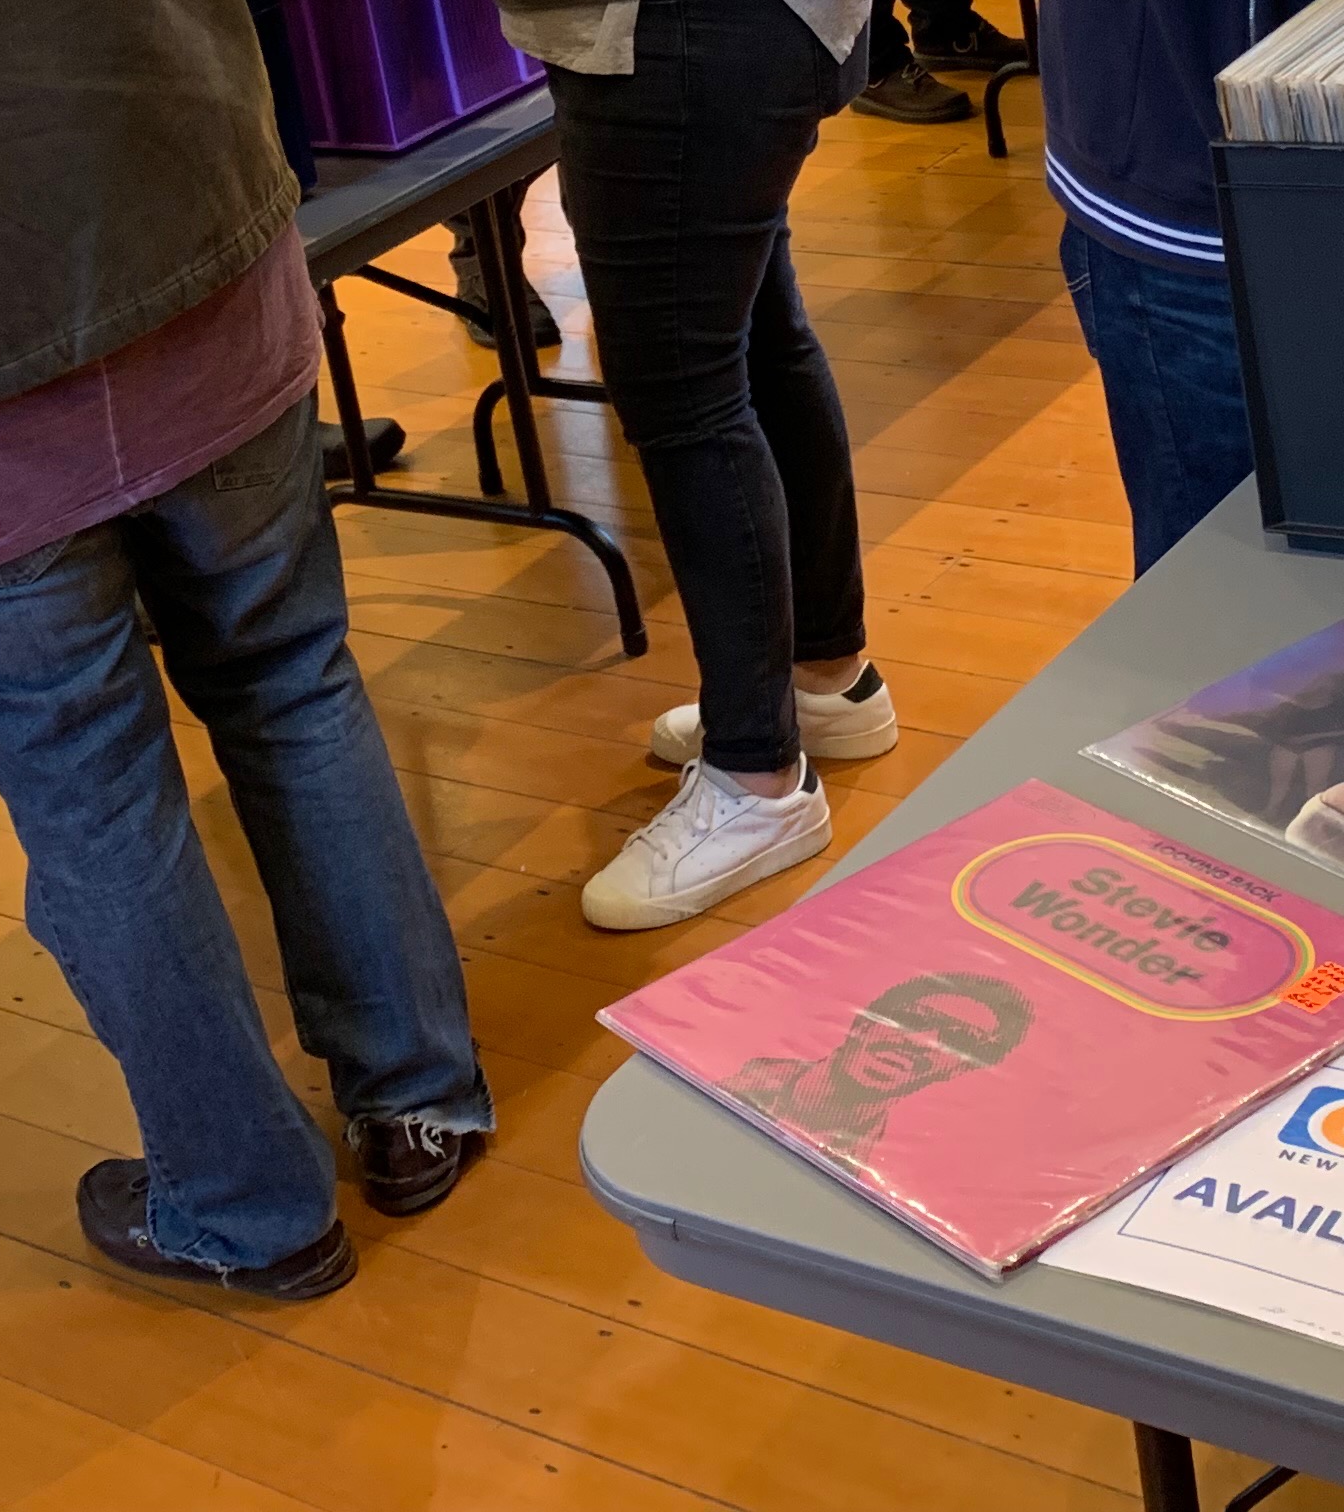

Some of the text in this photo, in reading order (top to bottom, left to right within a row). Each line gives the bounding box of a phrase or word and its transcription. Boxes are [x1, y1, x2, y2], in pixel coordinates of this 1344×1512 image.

[1152, 841, 1281, 904] LOOKING BACK
[1012, 880, 1208, 986] Wonder
[1069, 867, 1231, 953] Stevie
[1278, 1148, 1339, 1172] NEW
